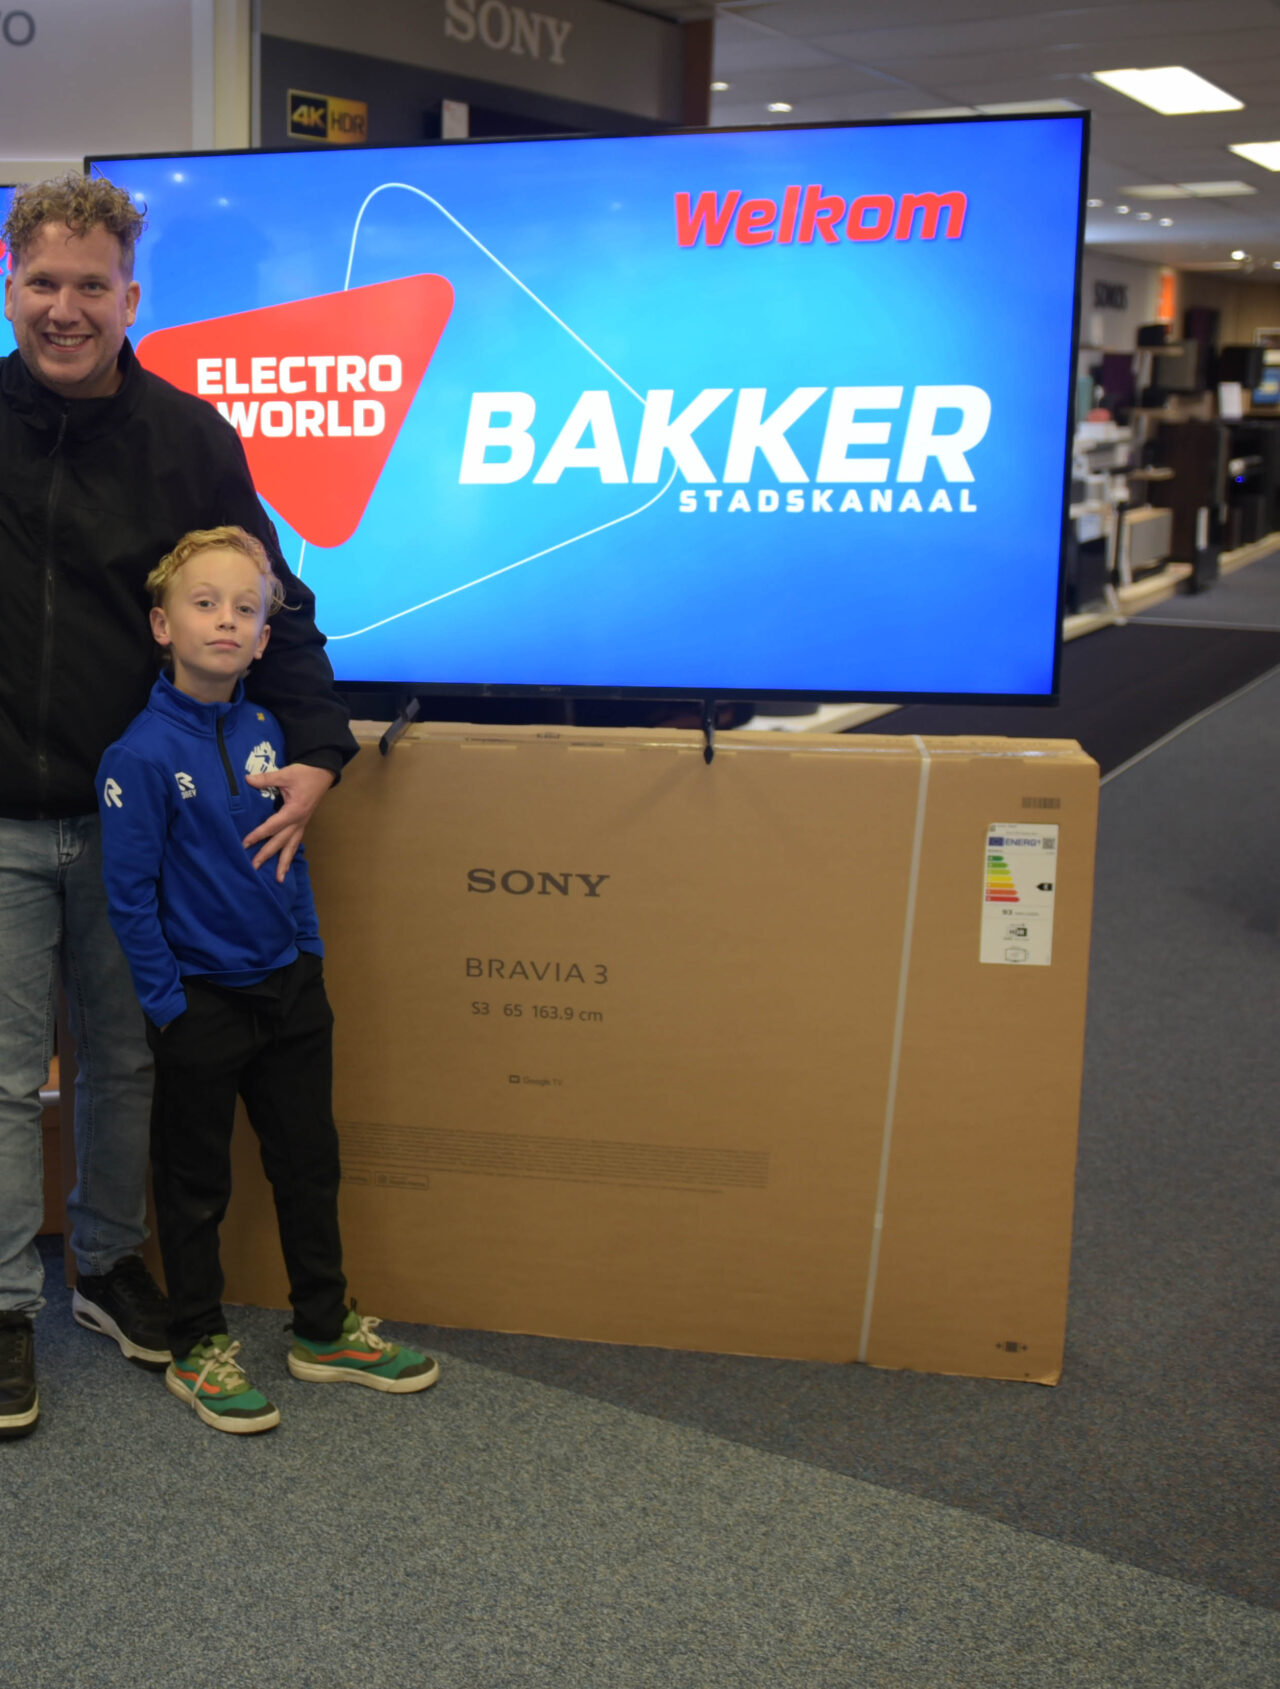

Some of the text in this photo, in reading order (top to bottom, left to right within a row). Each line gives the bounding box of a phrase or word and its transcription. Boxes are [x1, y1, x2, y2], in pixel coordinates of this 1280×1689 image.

[445, 0, 573, 64] SONY
[292, 104, 366, 136] 4K HDR
[674, 185, 968, 248] Welkom
[197, 354, 403, 395] ELECTRO
[216, 399, 386, 438] WORLD
[458, 384, 992, 484] BAKKER
[678, 488, 978, 513] STADSKANAAL
[467, 868, 610, 898] SONY
[465, 957, 609, 985] BRAVIA 3
[471, 1001, 603, 1022] S3 65 163.9 cm
